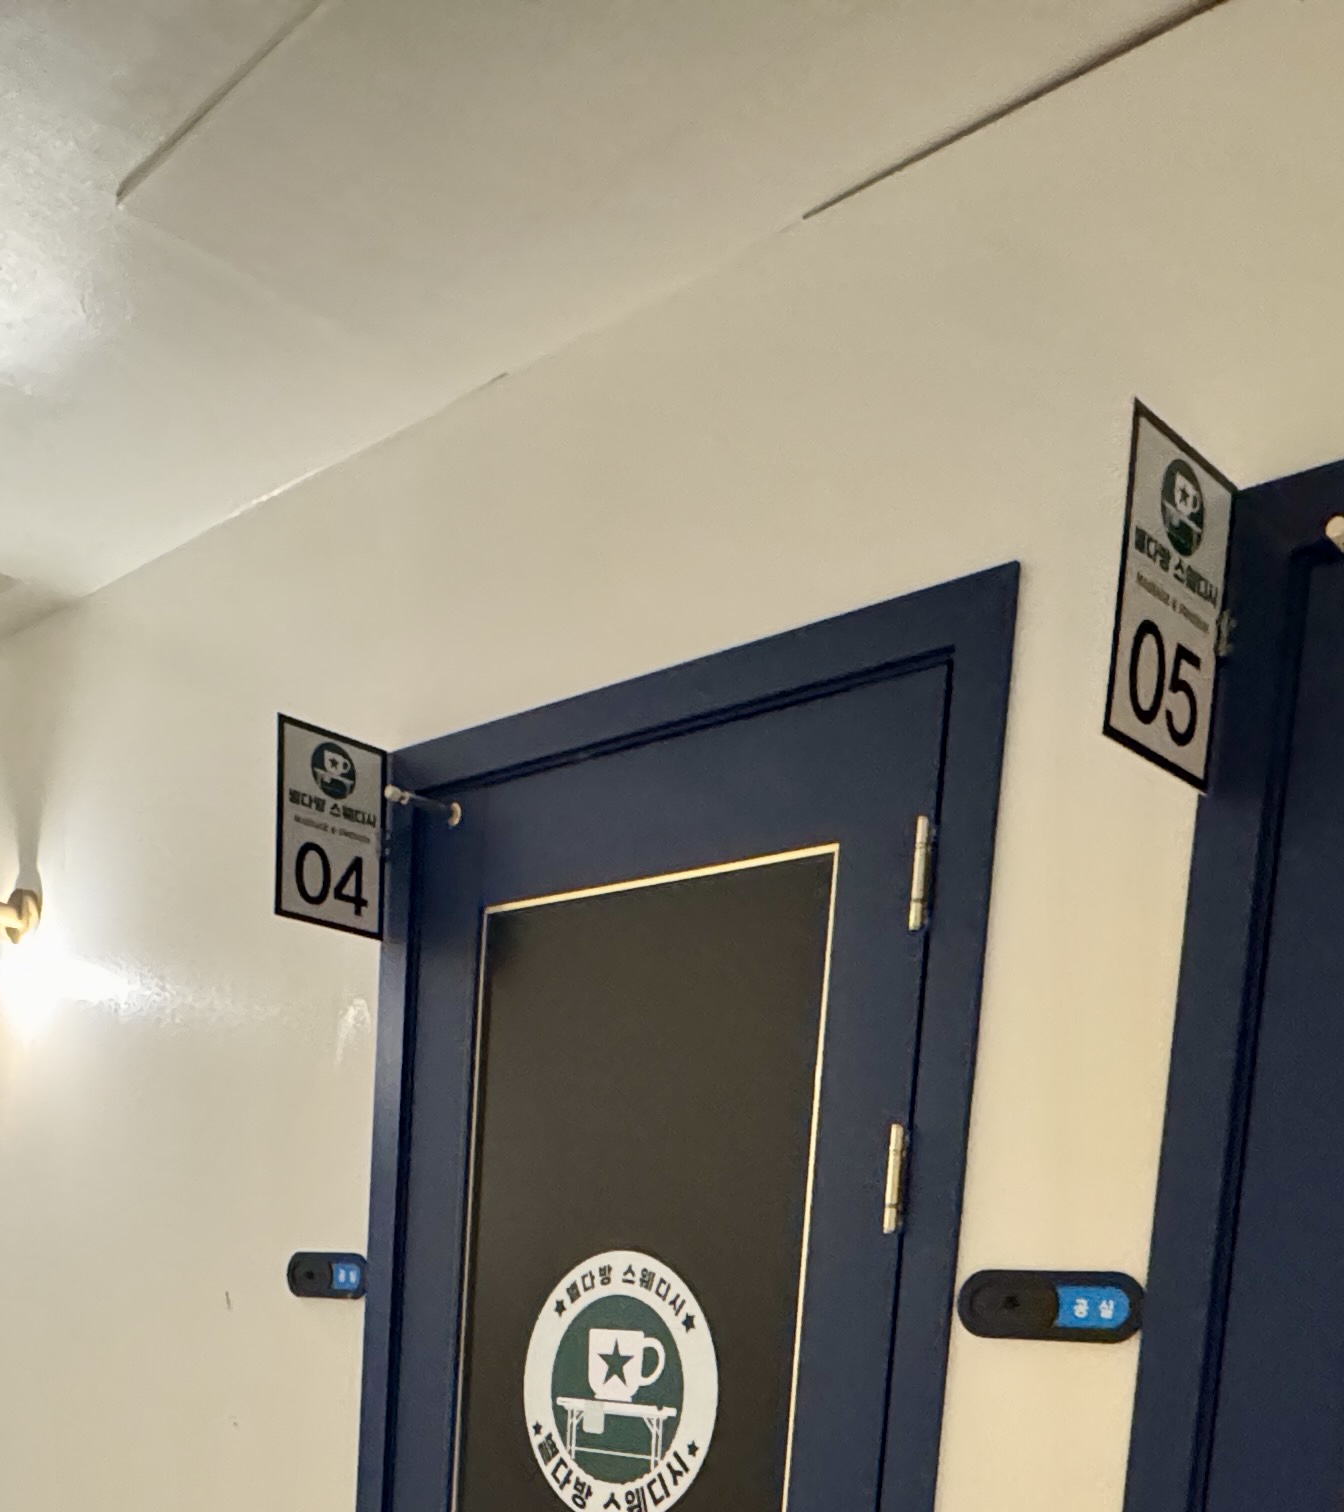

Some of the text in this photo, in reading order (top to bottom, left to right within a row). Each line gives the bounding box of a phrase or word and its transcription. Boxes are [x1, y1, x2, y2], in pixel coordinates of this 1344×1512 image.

[1173, 555, 1218, 609] 스디시
[1129, 618, 1201, 747] 05
[329, 799, 376, 829] 스디시
[295, 841, 369, 918] 04
[565, 1263, 686, 1317] 별다방 스웨디시
[537, 1432, 593, 1510] 별다방
